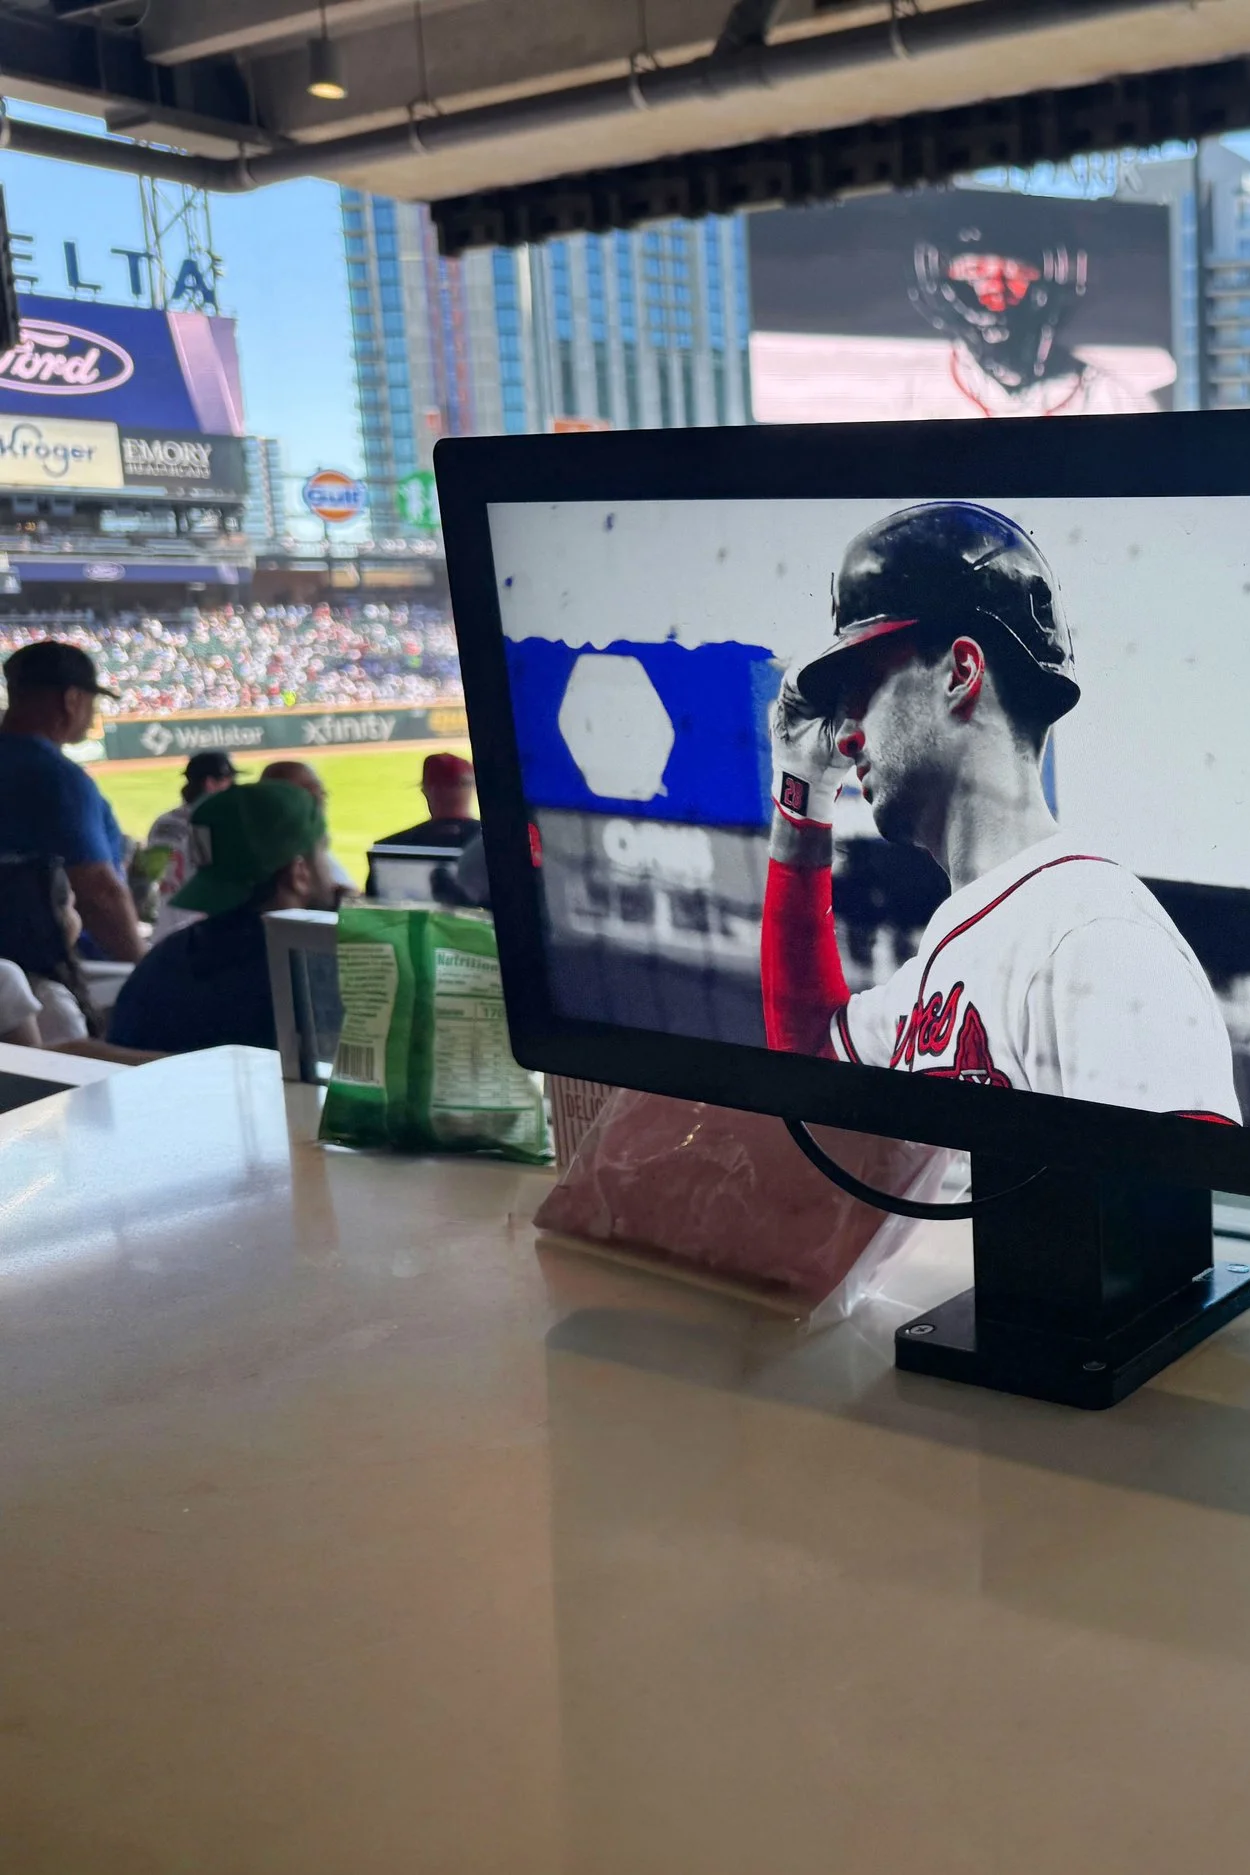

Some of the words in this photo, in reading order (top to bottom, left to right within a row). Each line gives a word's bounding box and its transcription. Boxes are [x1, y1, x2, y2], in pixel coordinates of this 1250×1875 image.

[0, 328, 101, 385] Ford
[0, 422, 98, 478] Kroger
[122, 437, 213, 466] EMORY
[174, 725, 265, 749] Wellstar
[301, 713, 397, 744] xfinity
